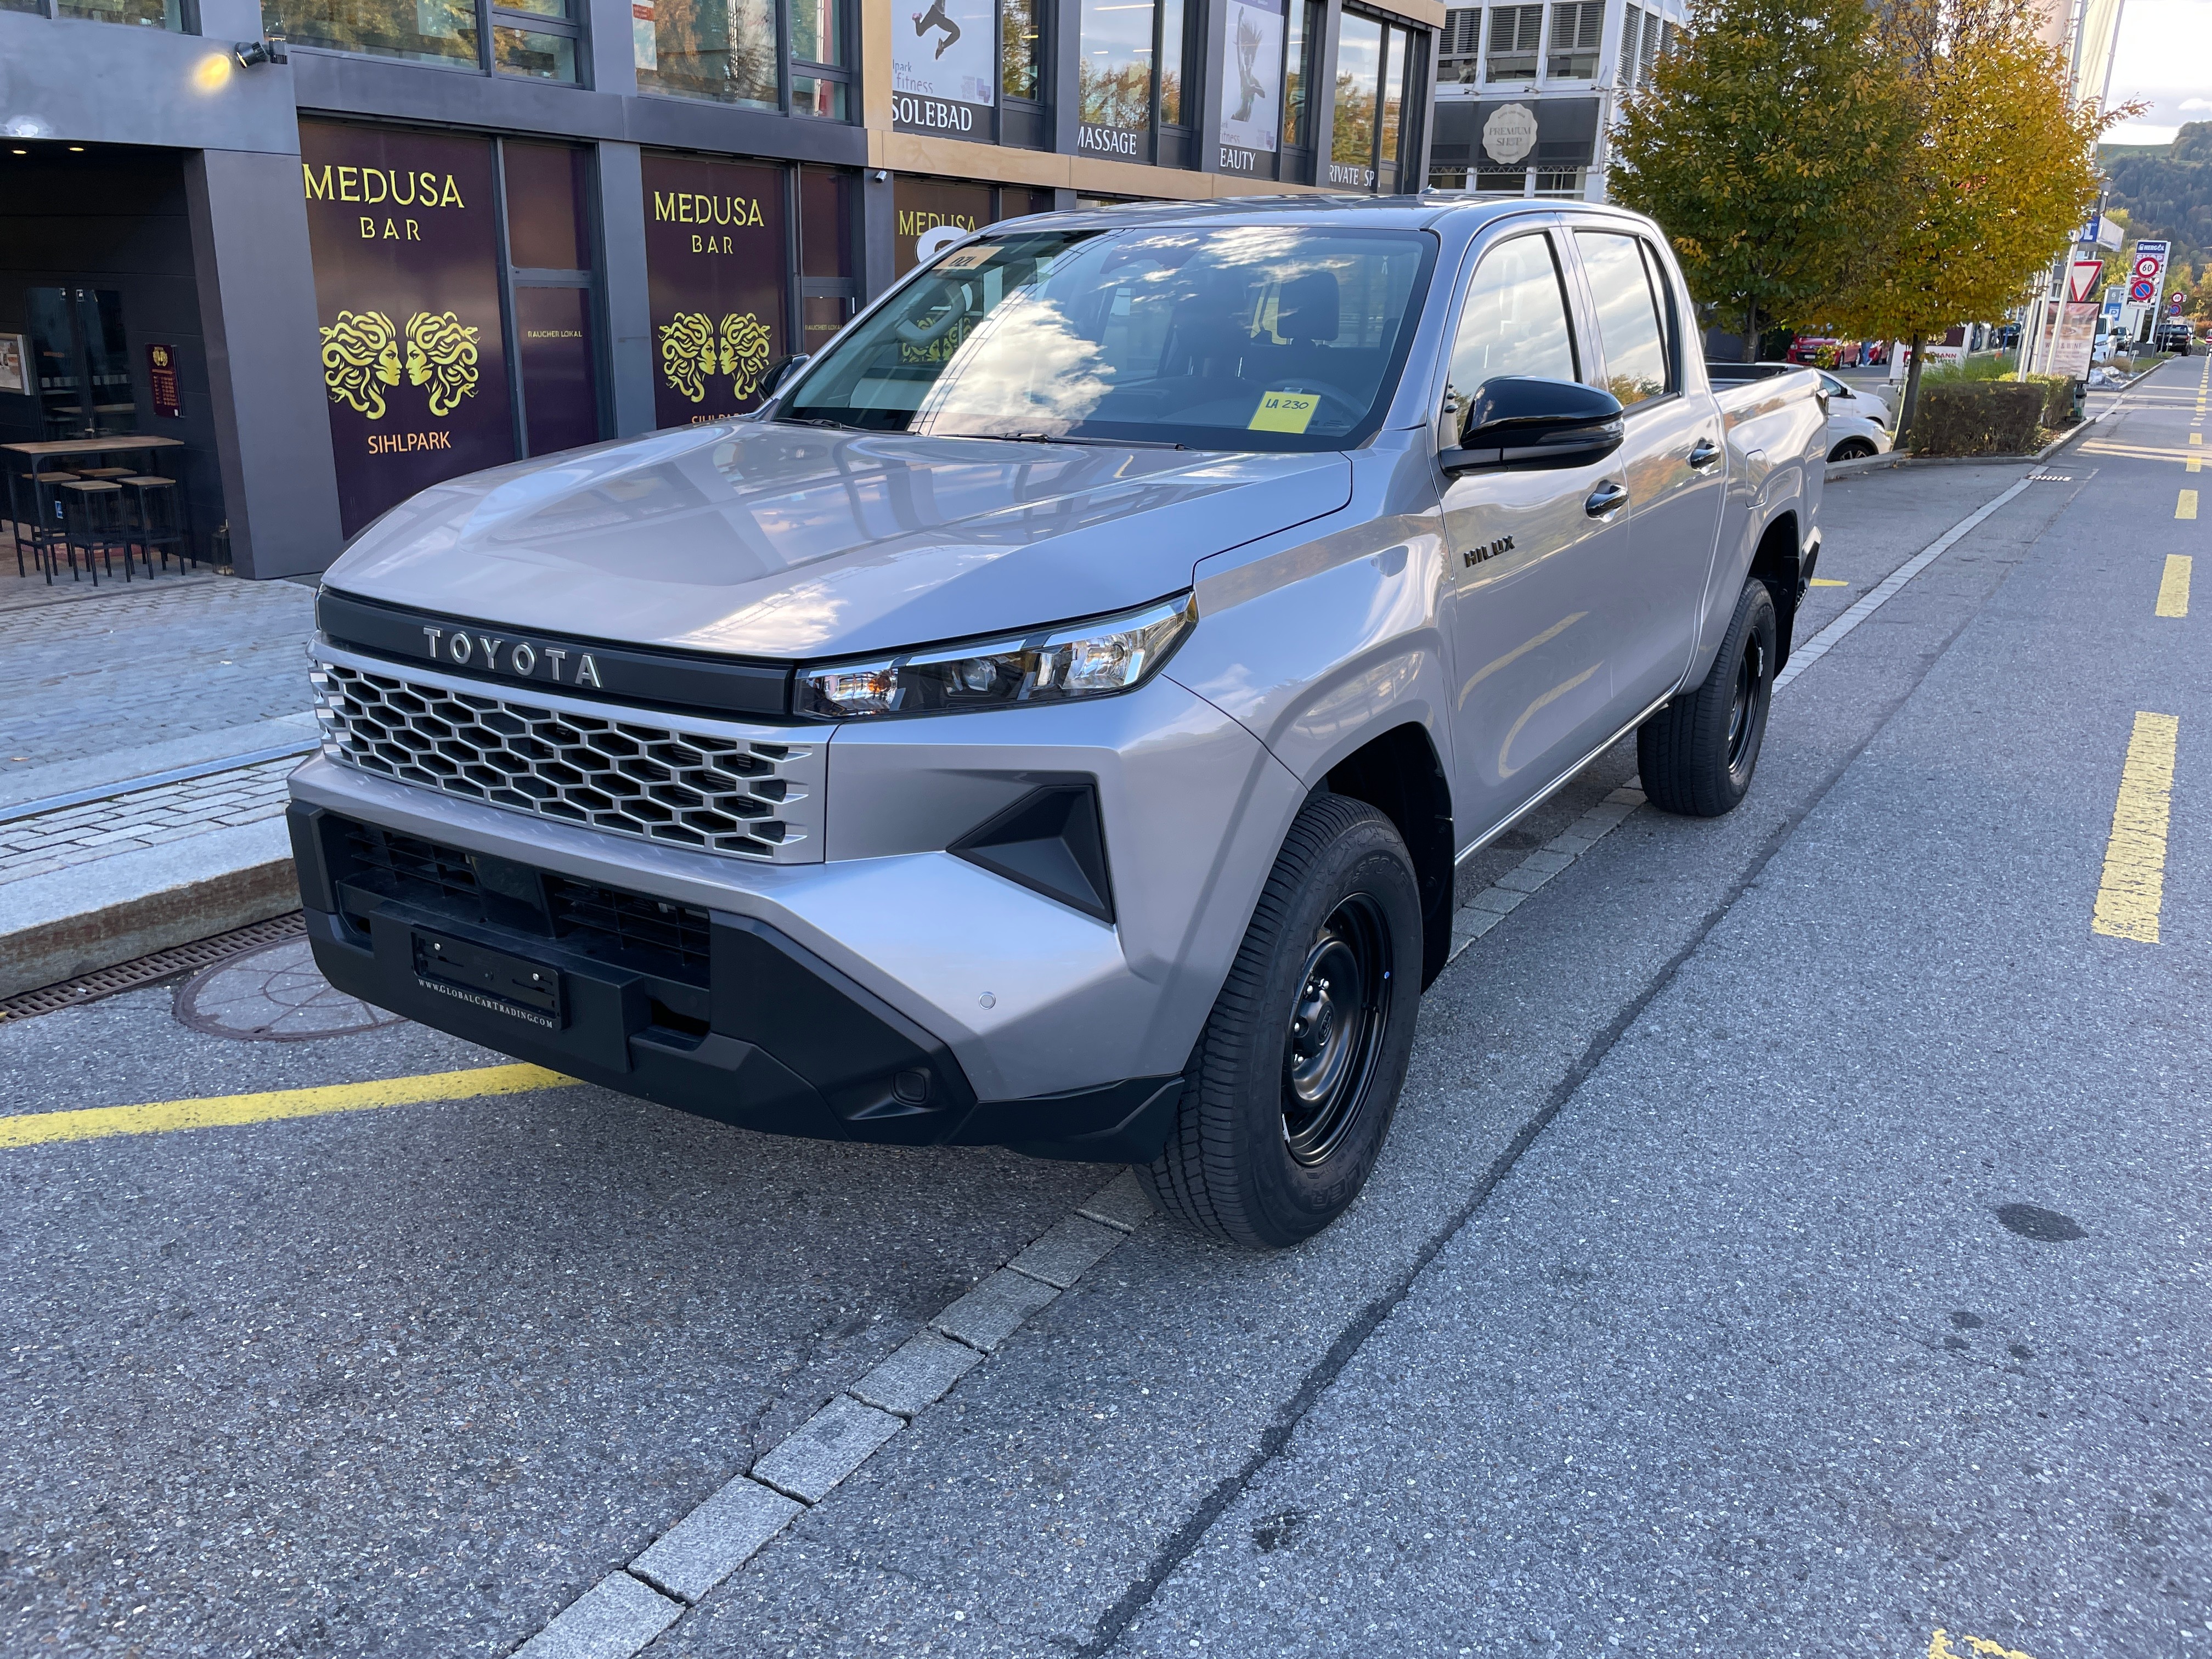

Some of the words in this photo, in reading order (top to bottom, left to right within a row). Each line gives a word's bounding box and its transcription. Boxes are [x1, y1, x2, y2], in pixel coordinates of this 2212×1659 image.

[896, 72, 933, 94] fitness
[891, 95, 973, 131] SOLEBAD
[1220, 131, 1240, 144] itness
[1489, 127, 1531, 136] PREMIUM
[302, 163, 465, 209] MEDUSA
[1364, 170, 1380, 188] SP
[653, 191, 765, 227] MEDUSA
[359, 216, 422, 241] BAR
[692, 235, 734, 254] BAR
[1265, 398, 1279, 409] LA
[1282, 400, 1309, 409] 230
[368, 431, 452, 455] SIHLPARK
[1463, 534, 1515, 568] HILUX
[423, 625, 603, 689] TOYOTA
